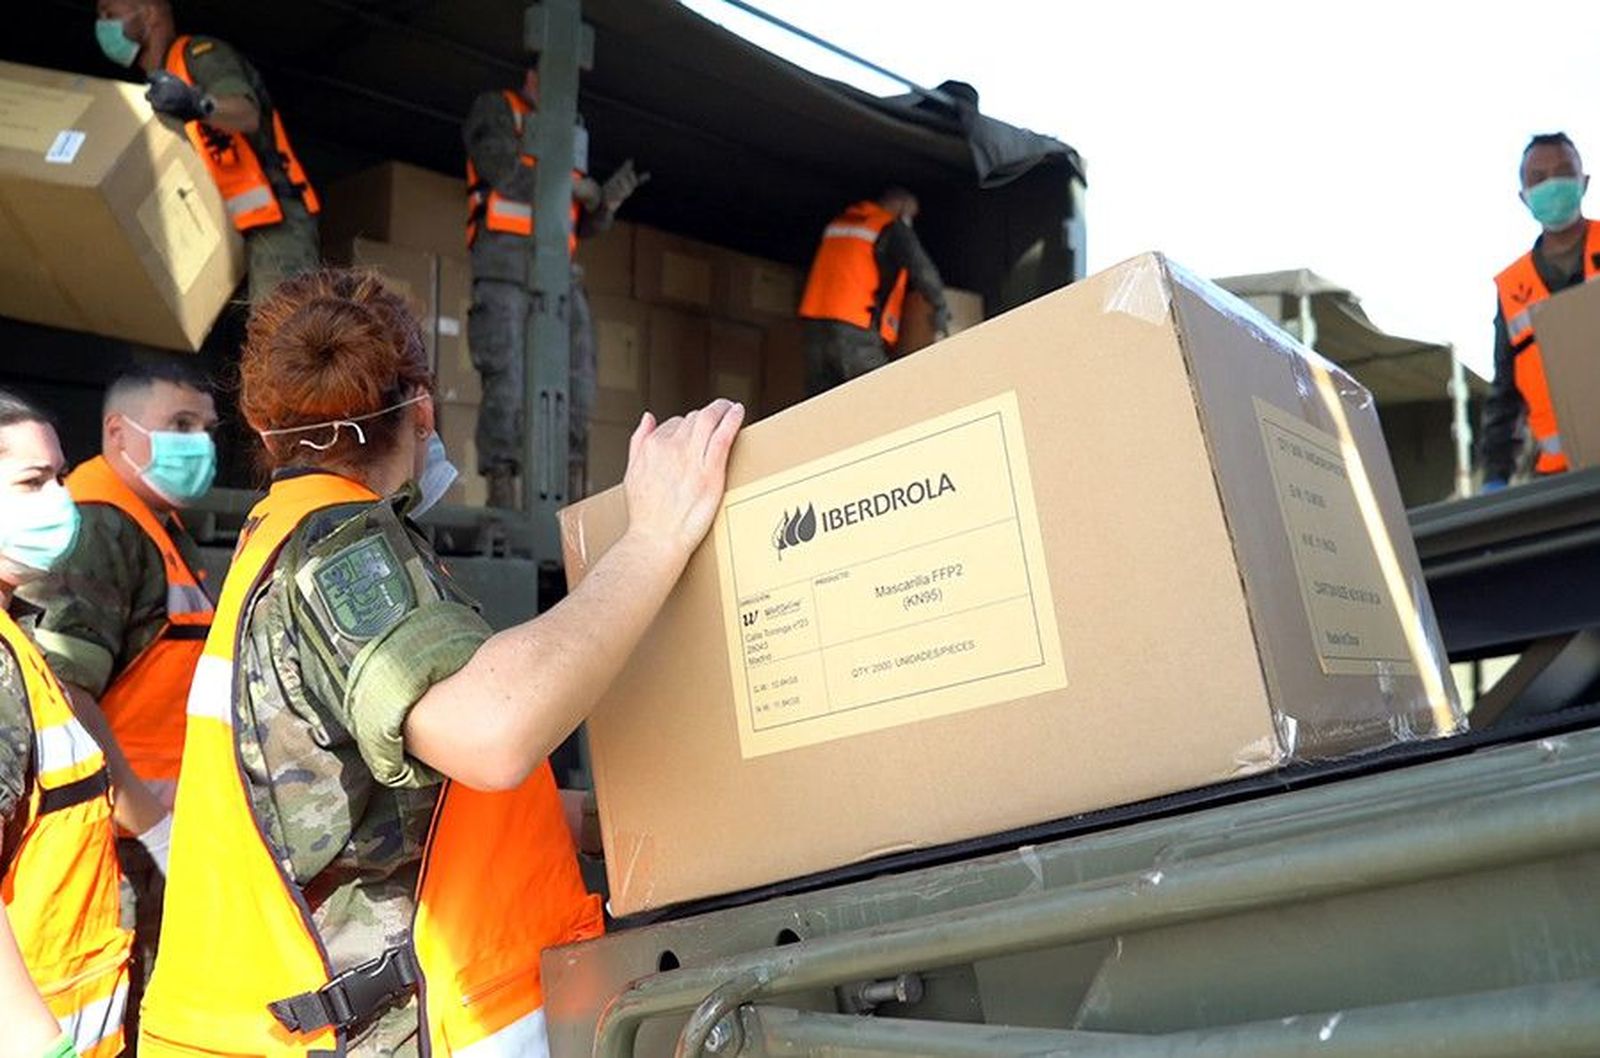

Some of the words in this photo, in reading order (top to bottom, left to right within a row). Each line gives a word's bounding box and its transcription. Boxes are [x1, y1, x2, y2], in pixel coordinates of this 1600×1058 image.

[821, 472, 956, 533] IBERDROLA
[932, 563, 963, 582] FFP2
[902, 587, 943, 612] (KN95)
